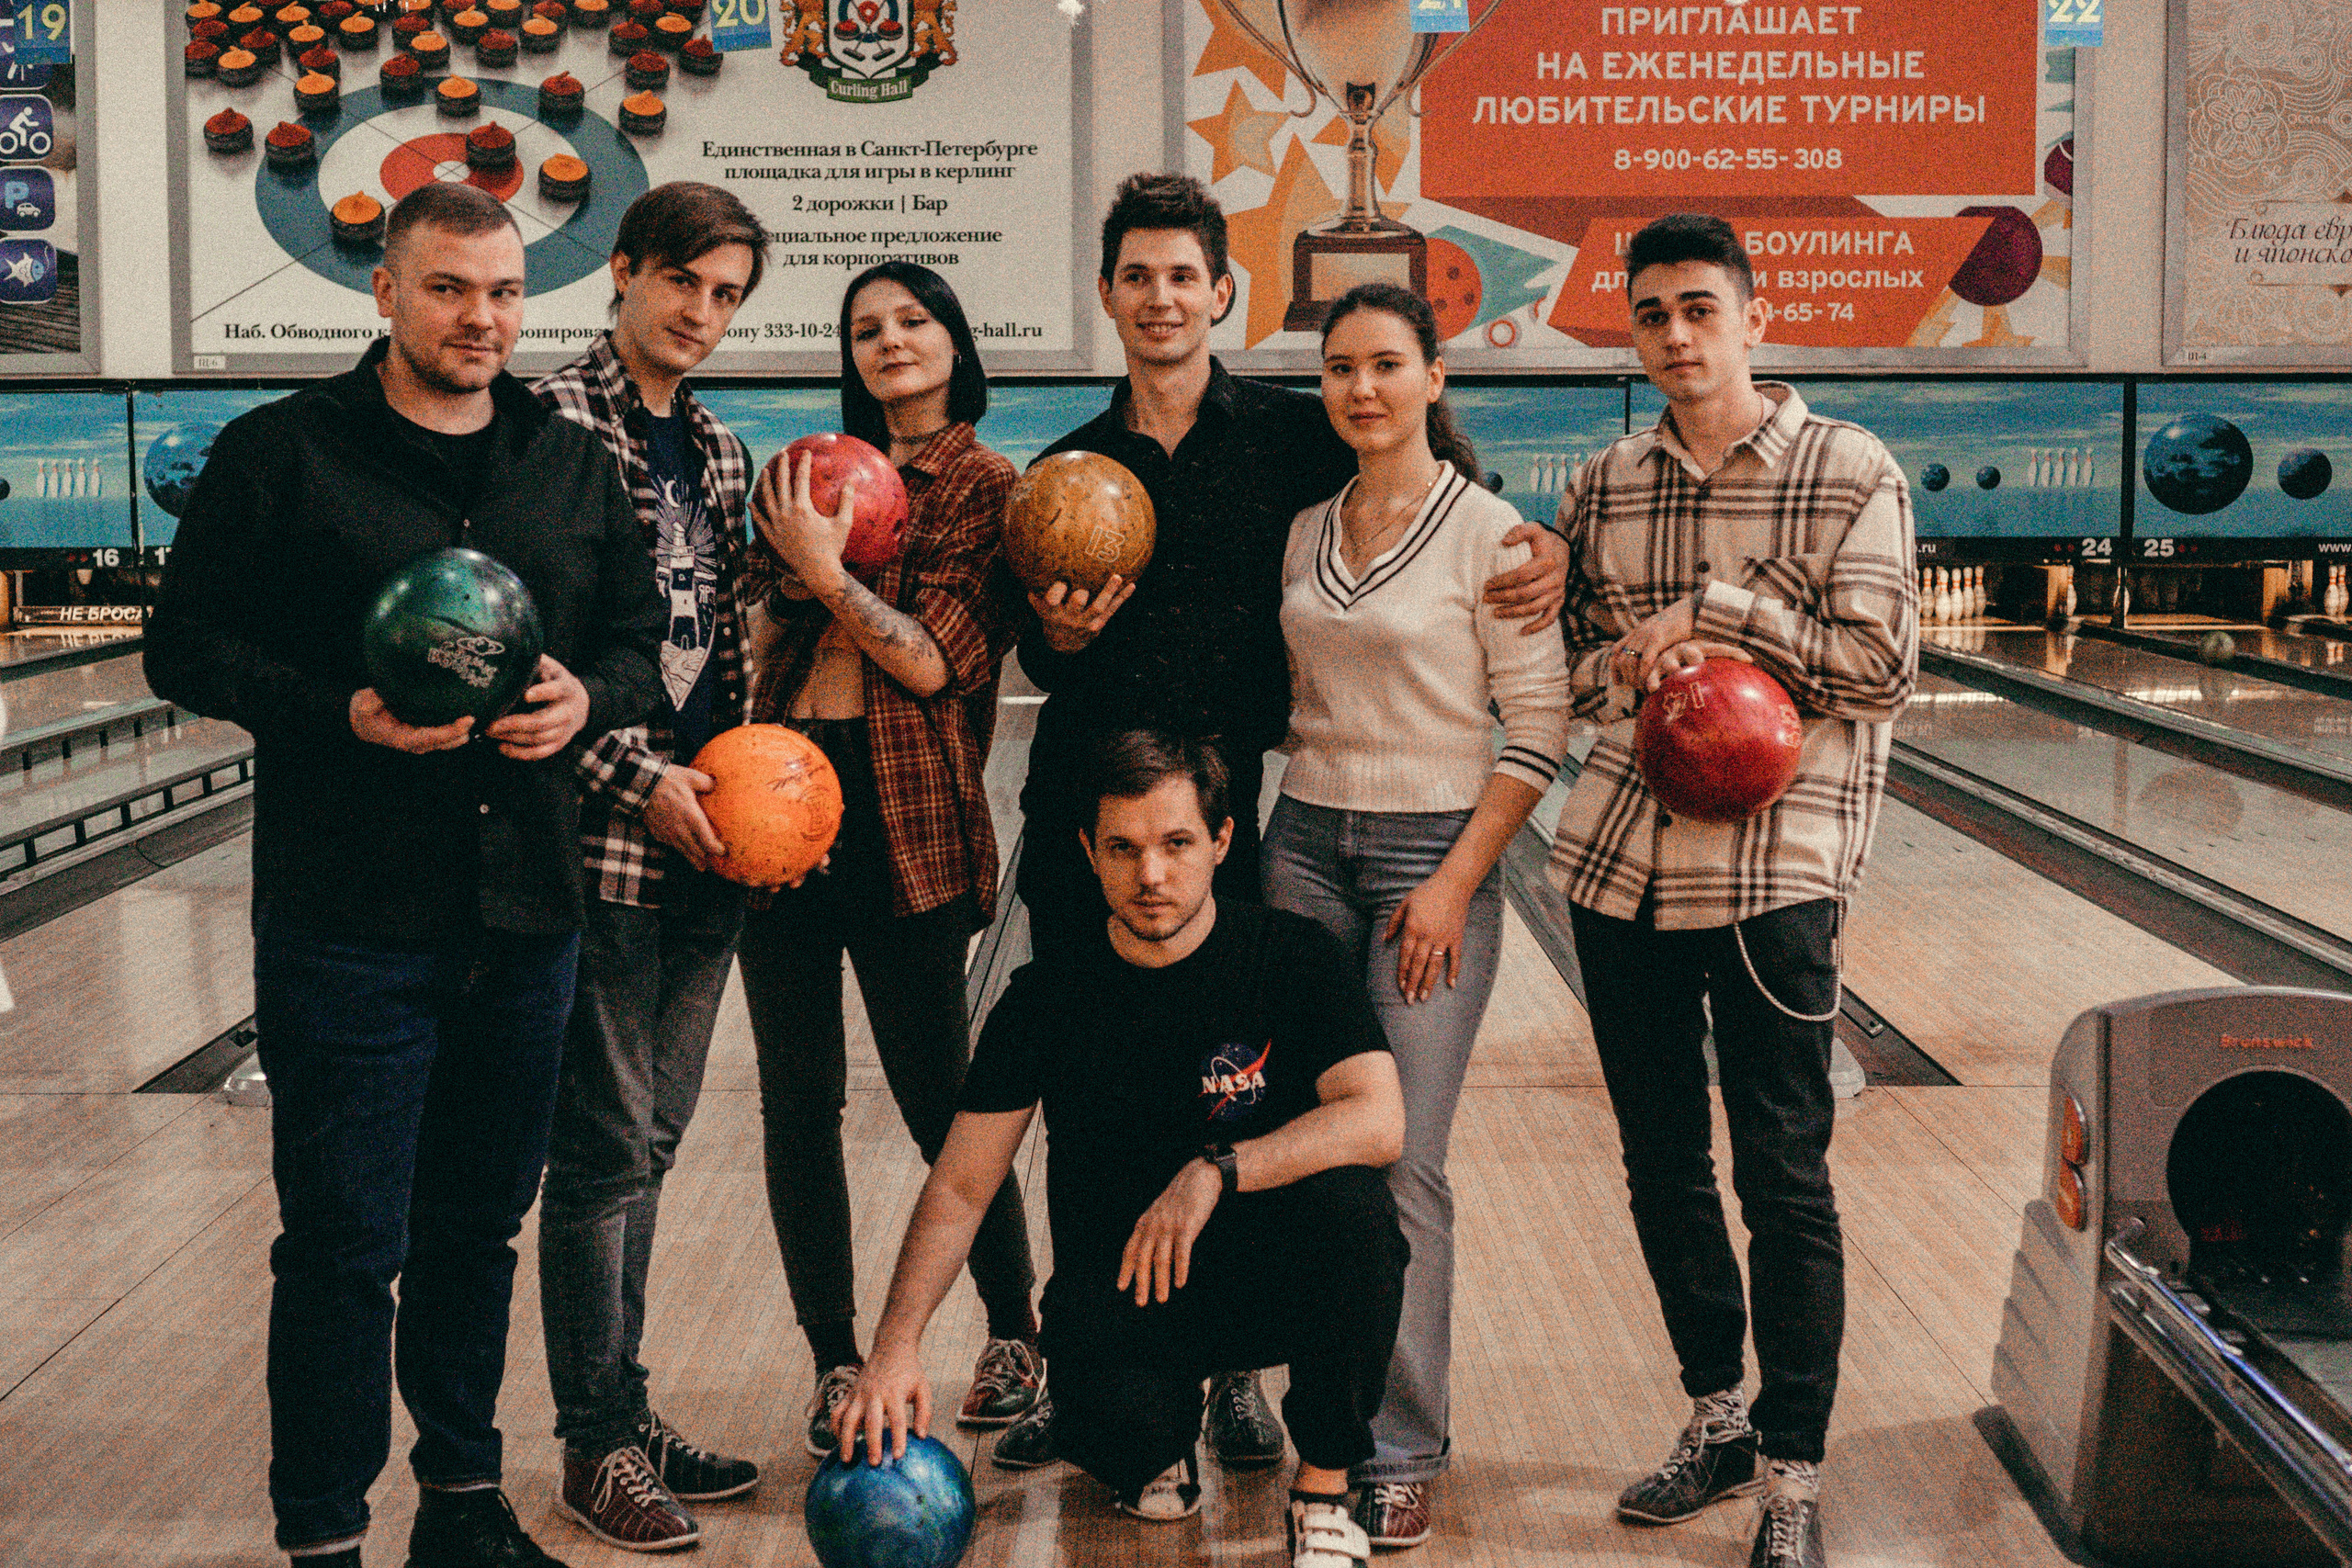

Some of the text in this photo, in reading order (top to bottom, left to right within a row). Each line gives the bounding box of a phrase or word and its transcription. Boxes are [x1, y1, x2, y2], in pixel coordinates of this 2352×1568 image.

[17, 3, 67, 41] 19
[712, 0, 766, 28] 20
[1601, 6, 1861, 35] ПРИГЛАШАЕТ
[2048, 0, 2101, 23] 22
[1537, 51, 1925, 85] НА ЕЖЕНЕДЕЛЬНЫЕ
[831, 80, 908, 100] Curling Hall
[1472, 95, 1985, 125] ЛЮБИТЕЛЬСКИЕ ТУРНИРЫ
[702, 140, 1038, 161] Единственная в Санкт-Петербурге
[724, 166, 1016, 185] площадка для игры в керлинг
[792, 194, 949, 217] 2 дорожки Бар
[871, 231, 1003, 249] предложение
[2225, 218, 2306, 246] Блюда
[1745, 231, 1915, 256] БОУЛИНГА
[783, 254, 819, 267] для
[2234, 247, 2250, 264] и
[1591, 269, 1924, 293] дл и взрослых
[224, 323, 266, 339] Наб.
[270, 323, 373, 341] Обводного
[93, 547, 119, 567] 16
[2081, 536, 2112, 557] 24
[2143, 537, 2175, 558] 25
[60, 606, 84, 621] НЕ
[1201, 1070, 1267, 1095] NASA
